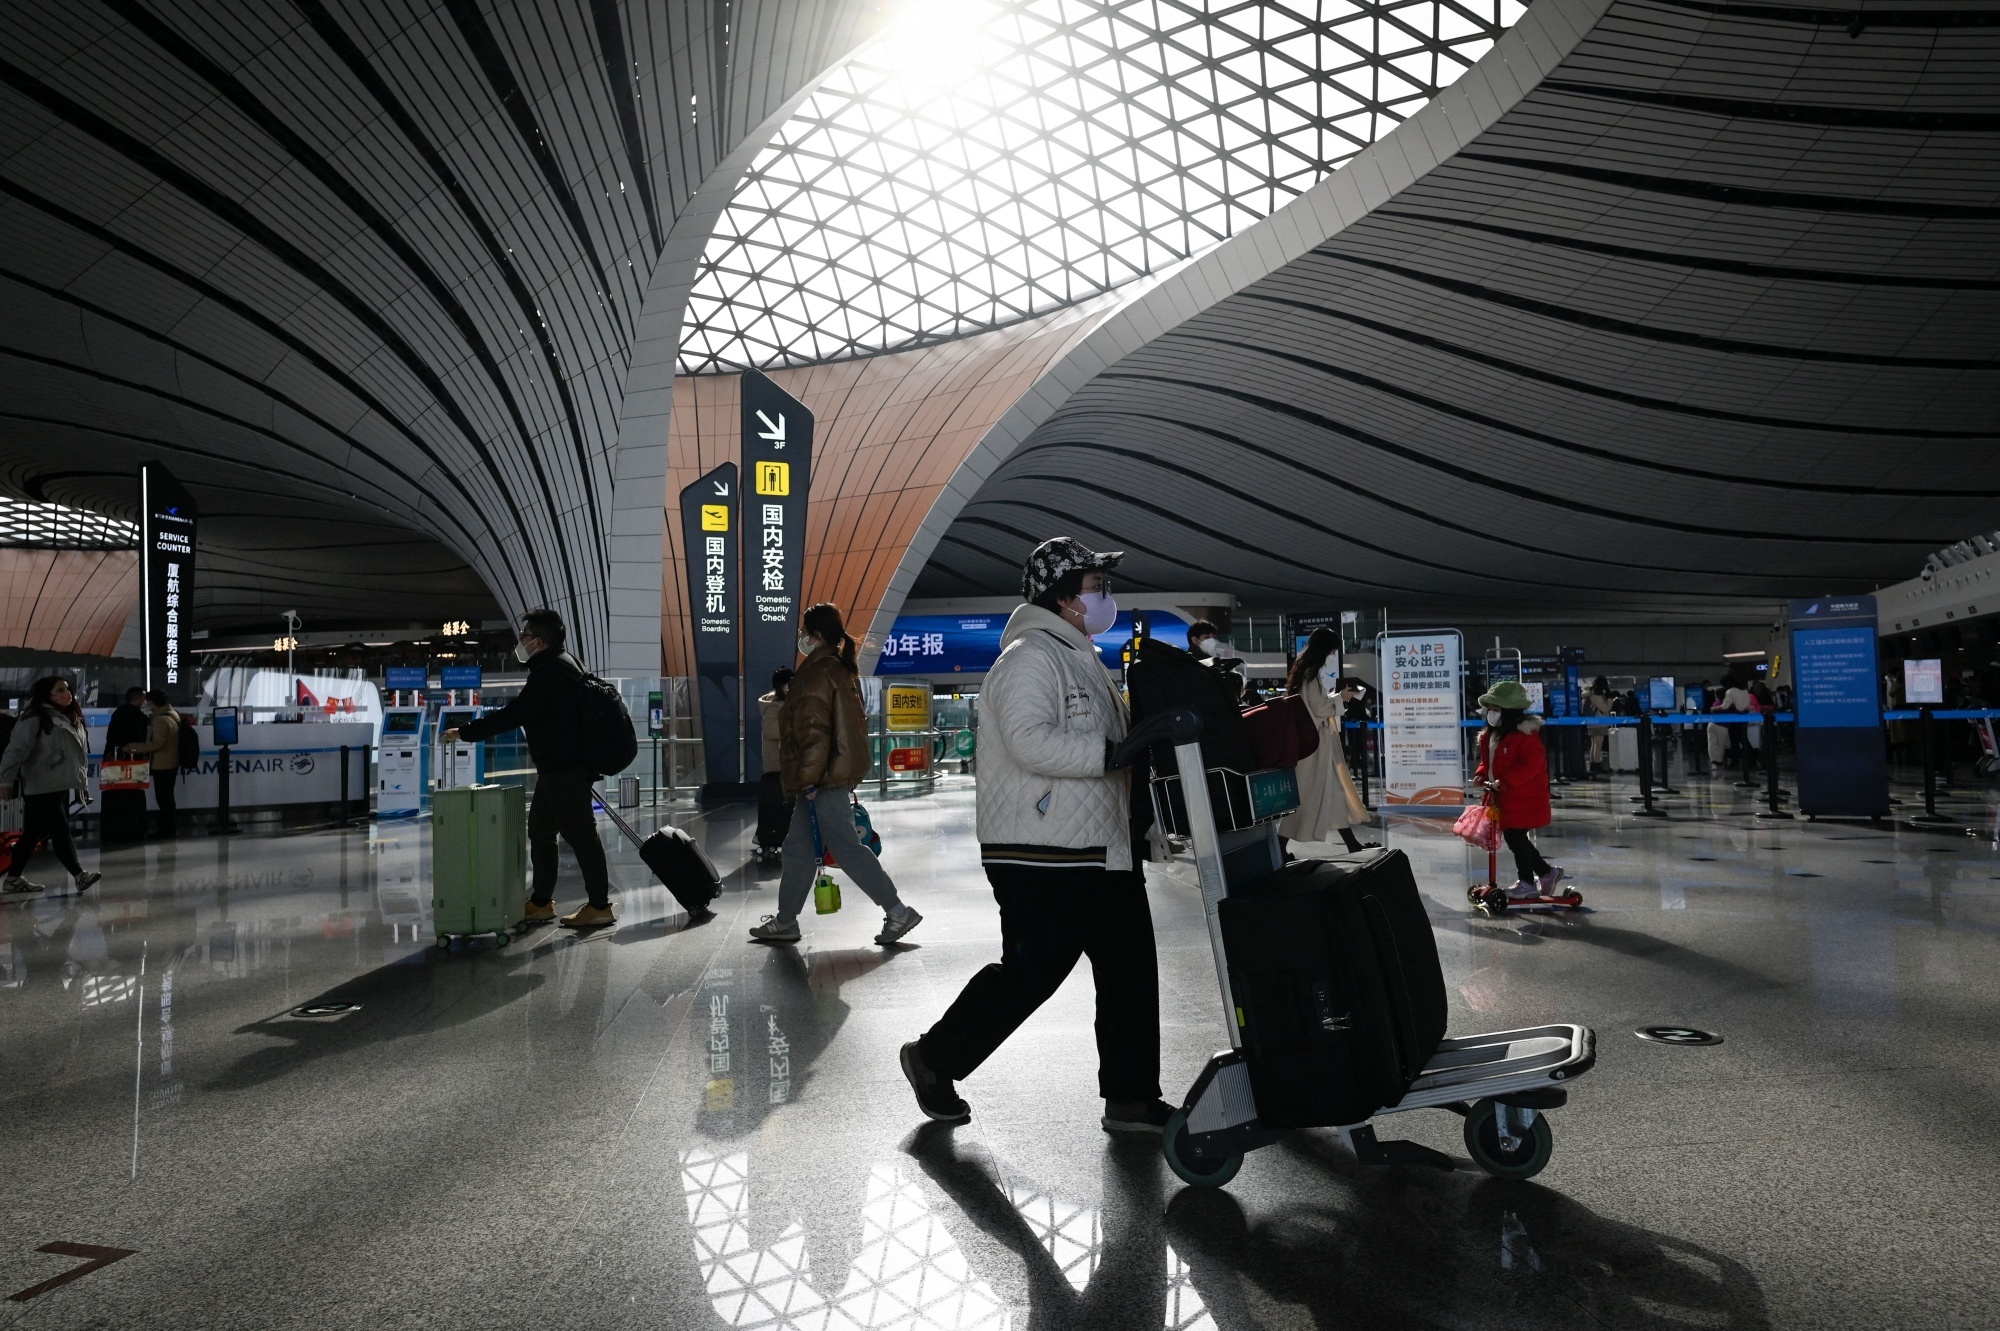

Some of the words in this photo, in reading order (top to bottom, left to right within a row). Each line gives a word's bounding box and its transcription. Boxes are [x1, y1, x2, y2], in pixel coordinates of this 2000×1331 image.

[774, 441, 786, 450] 3F
[159, 531, 189, 544] SERVICE
[156, 541, 191, 554] COUNTER
[762, 504, 784, 591] 国内安检
[706, 537, 726, 613] 国内登机
[756, 595, 792, 604] Domestic
[758, 604, 789, 614] Security
[166, 563, 180, 684] 厦航综合服务柜台
[761, 613, 786, 622] Check
[701, 625, 730, 634] Boarding
[1395, 643, 1445, 656] 护人护己
[1395, 655, 1446, 668] 安心出行
[1403, 670, 1450, 679] 正确佩戴口罩
[1403, 681, 1450, 690] 保持安全距离
[892, 694, 922, 709] 国内安检
